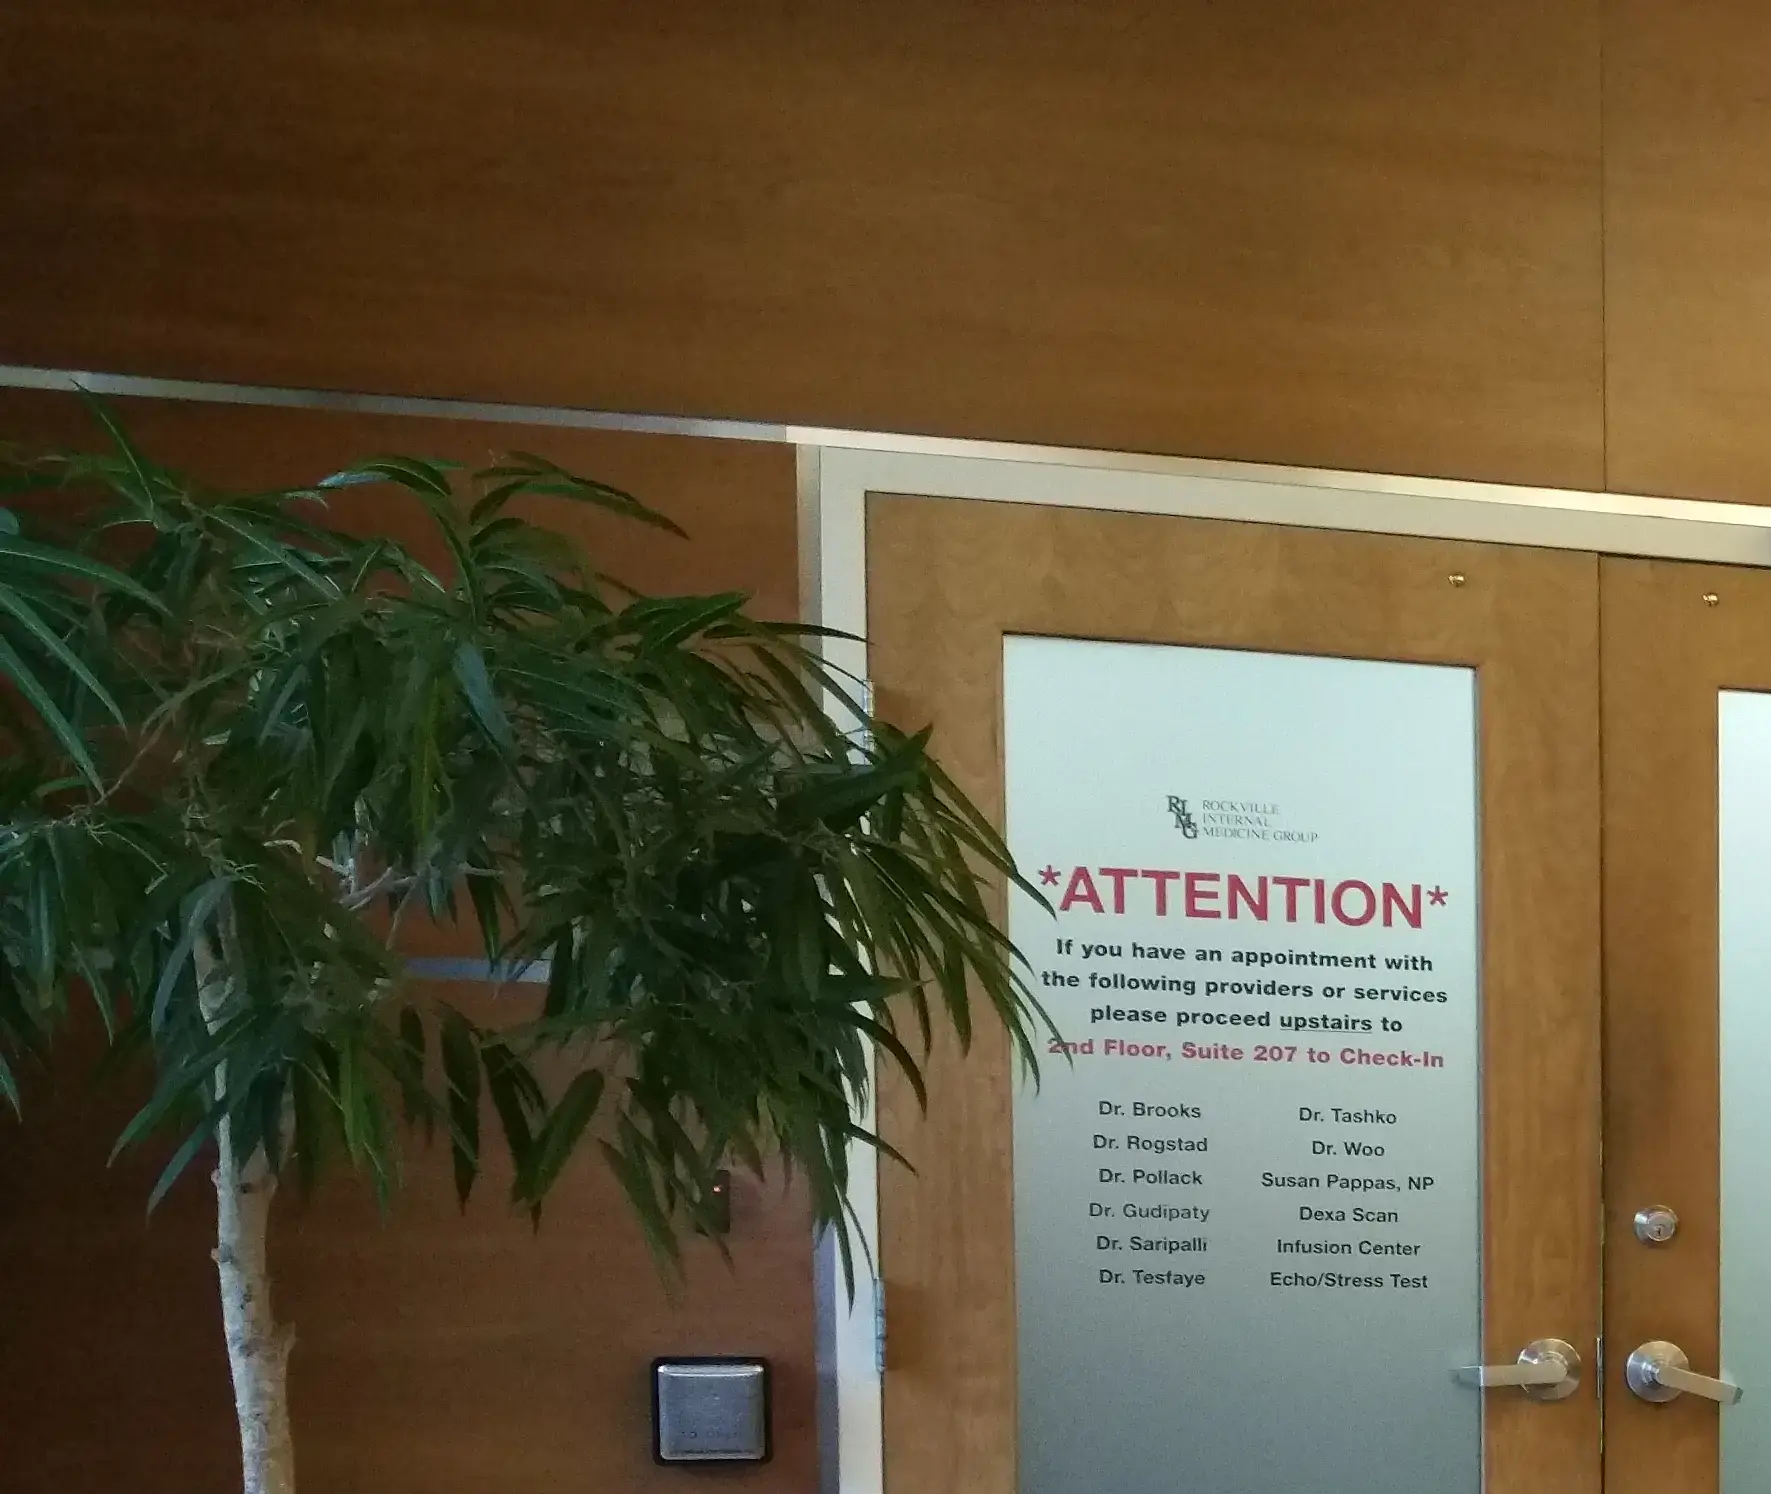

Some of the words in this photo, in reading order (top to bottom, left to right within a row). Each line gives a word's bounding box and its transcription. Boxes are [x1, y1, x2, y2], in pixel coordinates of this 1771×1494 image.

[1202, 800, 1279, 815] ROCKVILLE
[1202, 813, 1270, 826] INTERNAL
[1203, 826, 1270, 840] MEDICINE
[1274, 831, 1318, 843] GROUP
[1057, 940, 1073, 957] If
[1082, 944, 1122, 961] you
[1132, 943, 1186, 962] have
[1195, 948, 1222, 962] an
[1232, 947, 1376, 969] appointment
[1385, 953, 1432, 971] with
[1041, 971, 1080, 987] the
[1089, 973, 1196, 996] following
[1205, 978, 1313, 998] providers
[1323, 983, 1345, 998] or
[1354, 986, 1447, 1004] services
[1091, 1005, 1167, 1026] please
[1177, 1009, 1271, 1030] proceed
[1280, 1013, 1372, 1034] upstairs
[1382, 1015, 1402, 1033] to
[1048, 1037, 1093, 1057] 2nd
[1104, 1040, 1172, 1061] Floor,
[1182, 1042, 1244, 1061] Suite
[1254, 1045, 1297, 1062] 207
[1308, 1047, 1330, 1064] to
[1341, 1047, 1444, 1068] Check-In
[1099, 1101, 1125, 1117] Dr.
[1132, 1102, 1201, 1118] Brooks
[1299, 1107, 1324, 1123] Dr.
[1331, 1108, 1396, 1125] Tashko
[1094, 1135, 1119, 1150] Dr.
[1127, 1136, 1208, 1155] Rogstad
[1312, 1141, 1337, 1156] Dr.
[1345, 1141, 1385, 1157] Woo
[1099, 1169, 1126, 1184] Dr.
[1133, 1169, 1202, 1185] Pollack
[1261, 1173, 1319, 1189] Susan
[1327, 1174, 1400, 1192] Pappas,
[1408, 1176, 1434, 1191] NP
[1089, 1203, 1116, 1218] Dr.
[1123, 1203, 1210, 1223] Gudipaty
[1299, 1207, 1346, 1222] Dexa
[1353, 1207, 1398, 1223] Scan
[1096, 1236, 1123, 1251] Dr.
[1130, 1236, 1207, 1255] Saripalli
[1277, 1239, 1351, 1256] Infusion
[1359, 1241, 1420, 1257] Center
[1099, 1269, 1126, 1284] Dr.
[1133, 1269, 1205, 1289] Tesfaye
[1270, 1272, 1383, 1289] Echo/Stress
[1390, 1274, 1428, 1289] Test
